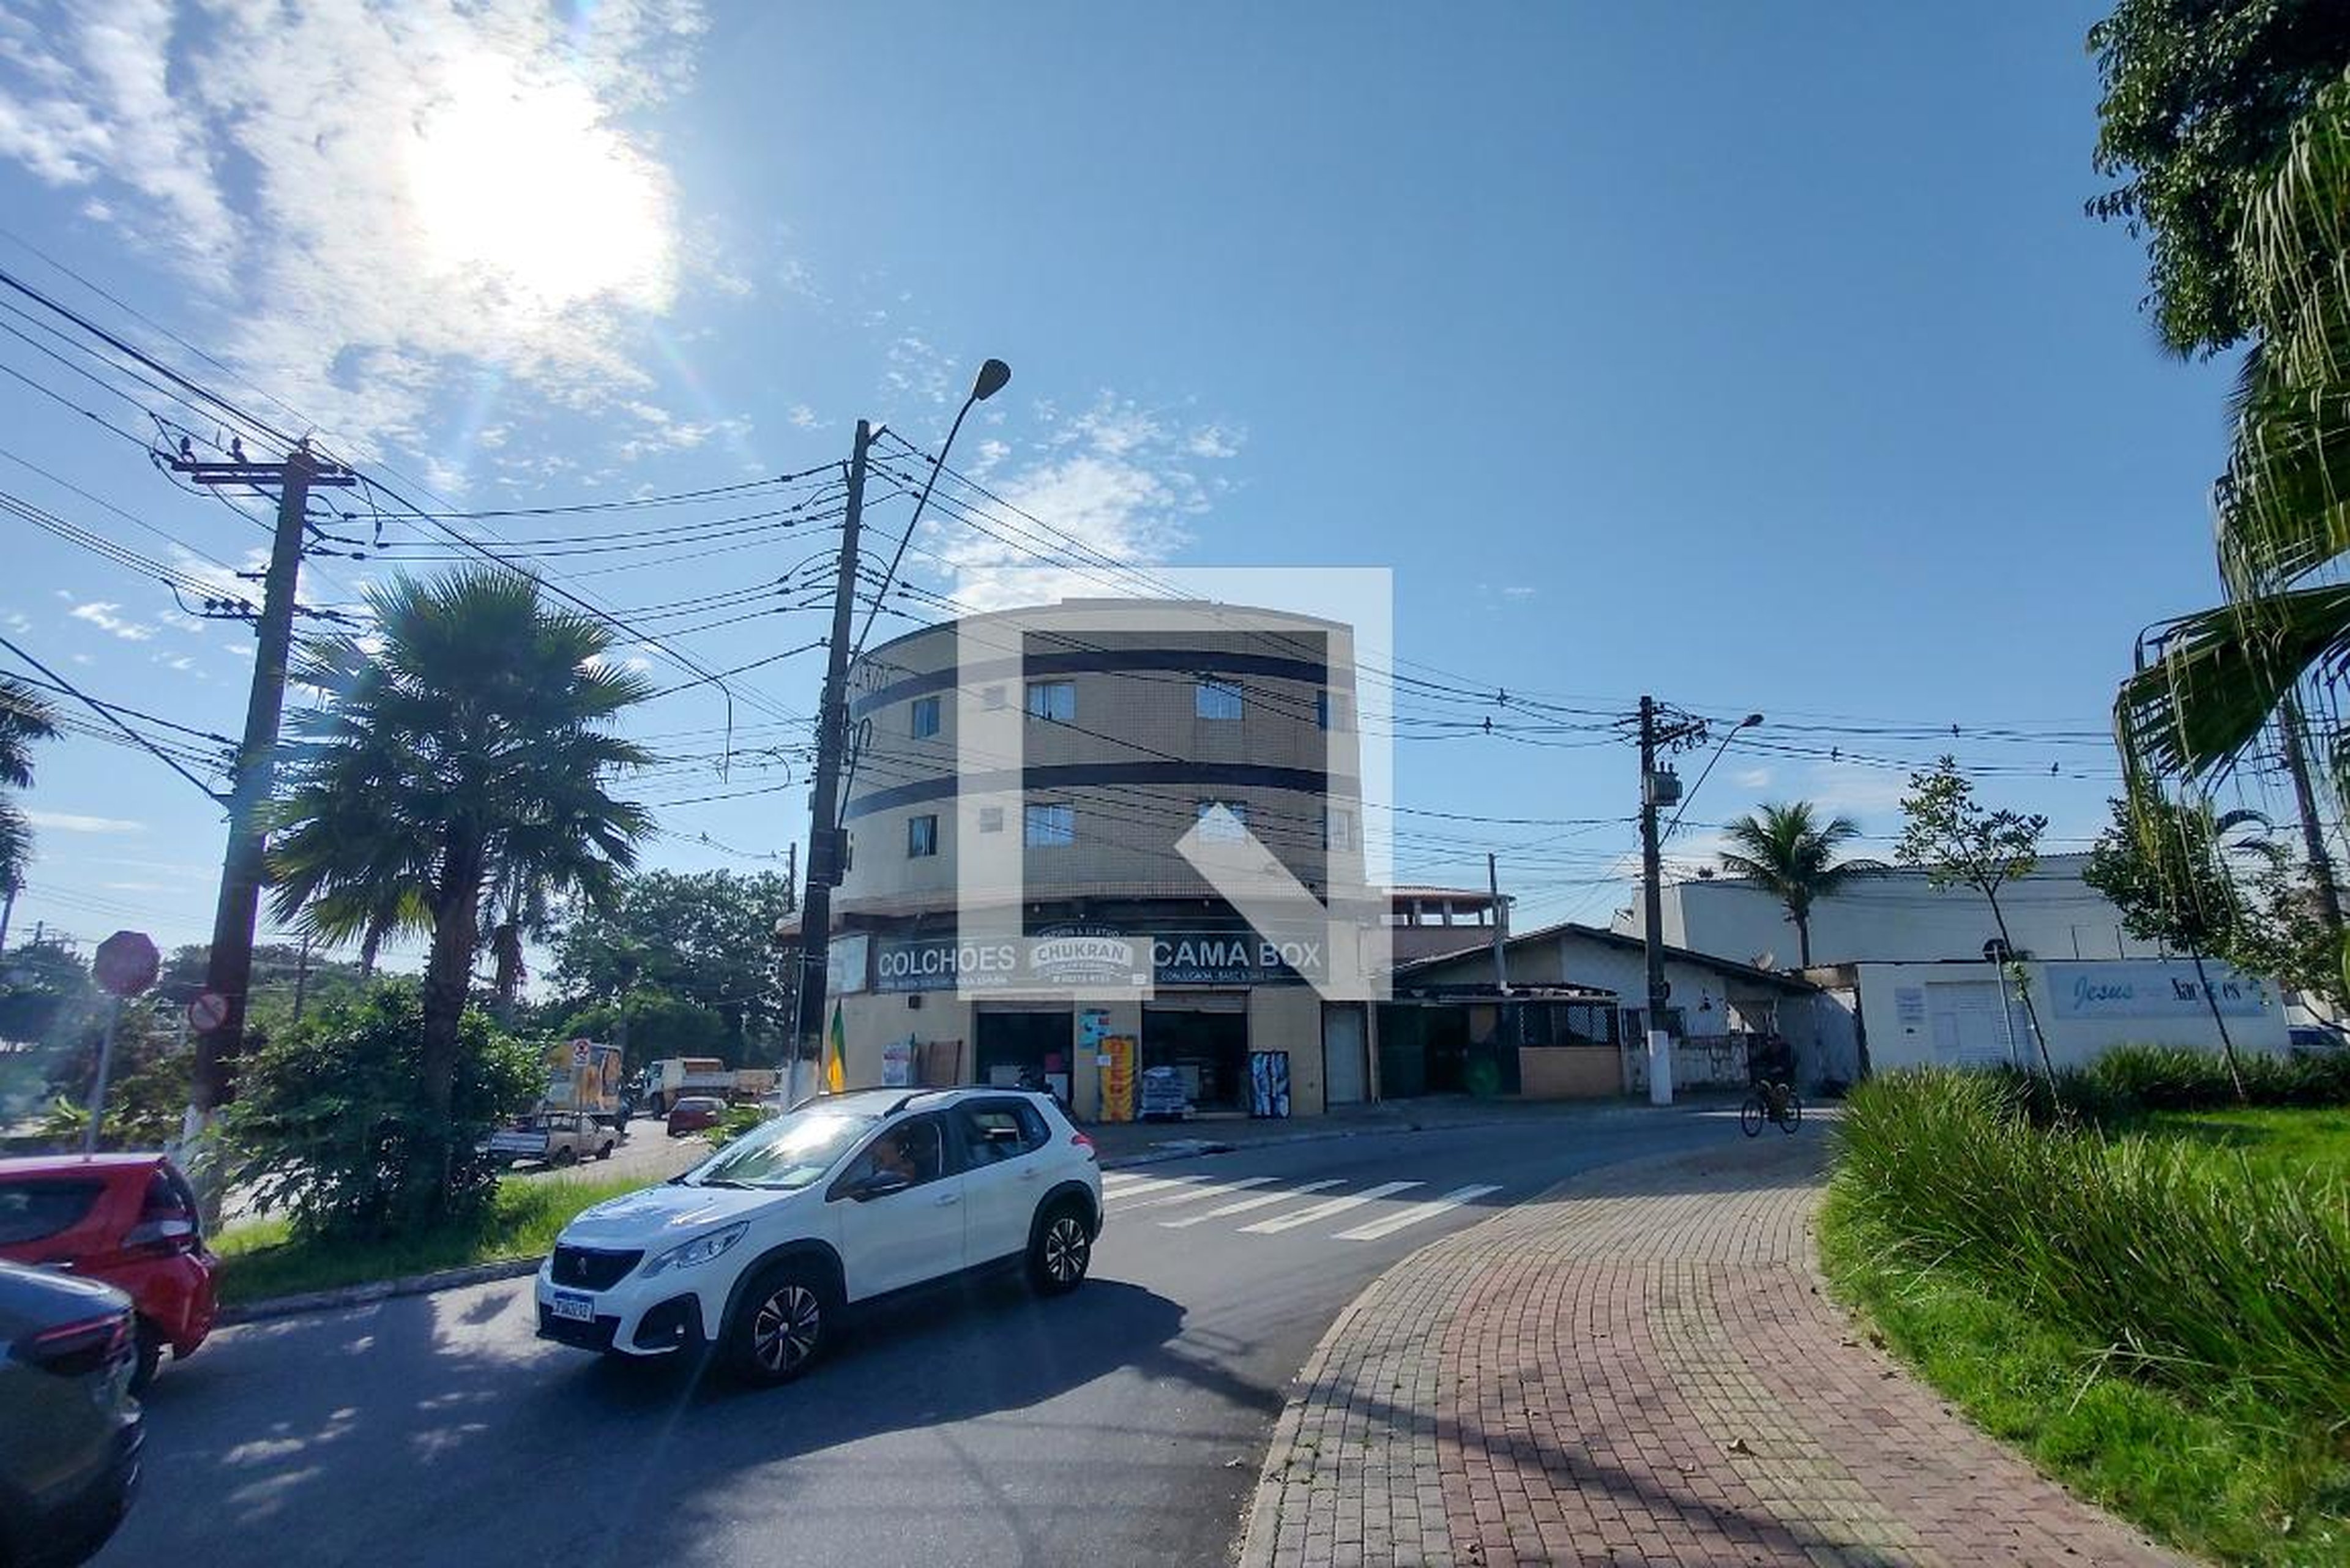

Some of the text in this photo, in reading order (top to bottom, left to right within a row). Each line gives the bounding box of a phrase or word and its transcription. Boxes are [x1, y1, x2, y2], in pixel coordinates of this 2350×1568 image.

[878, 942, 1016, 977] COLCHÕES
[1037, 943, 1125, 961] CHUKRAN
[1149, 941, 1322, 967] CAMA BOX
